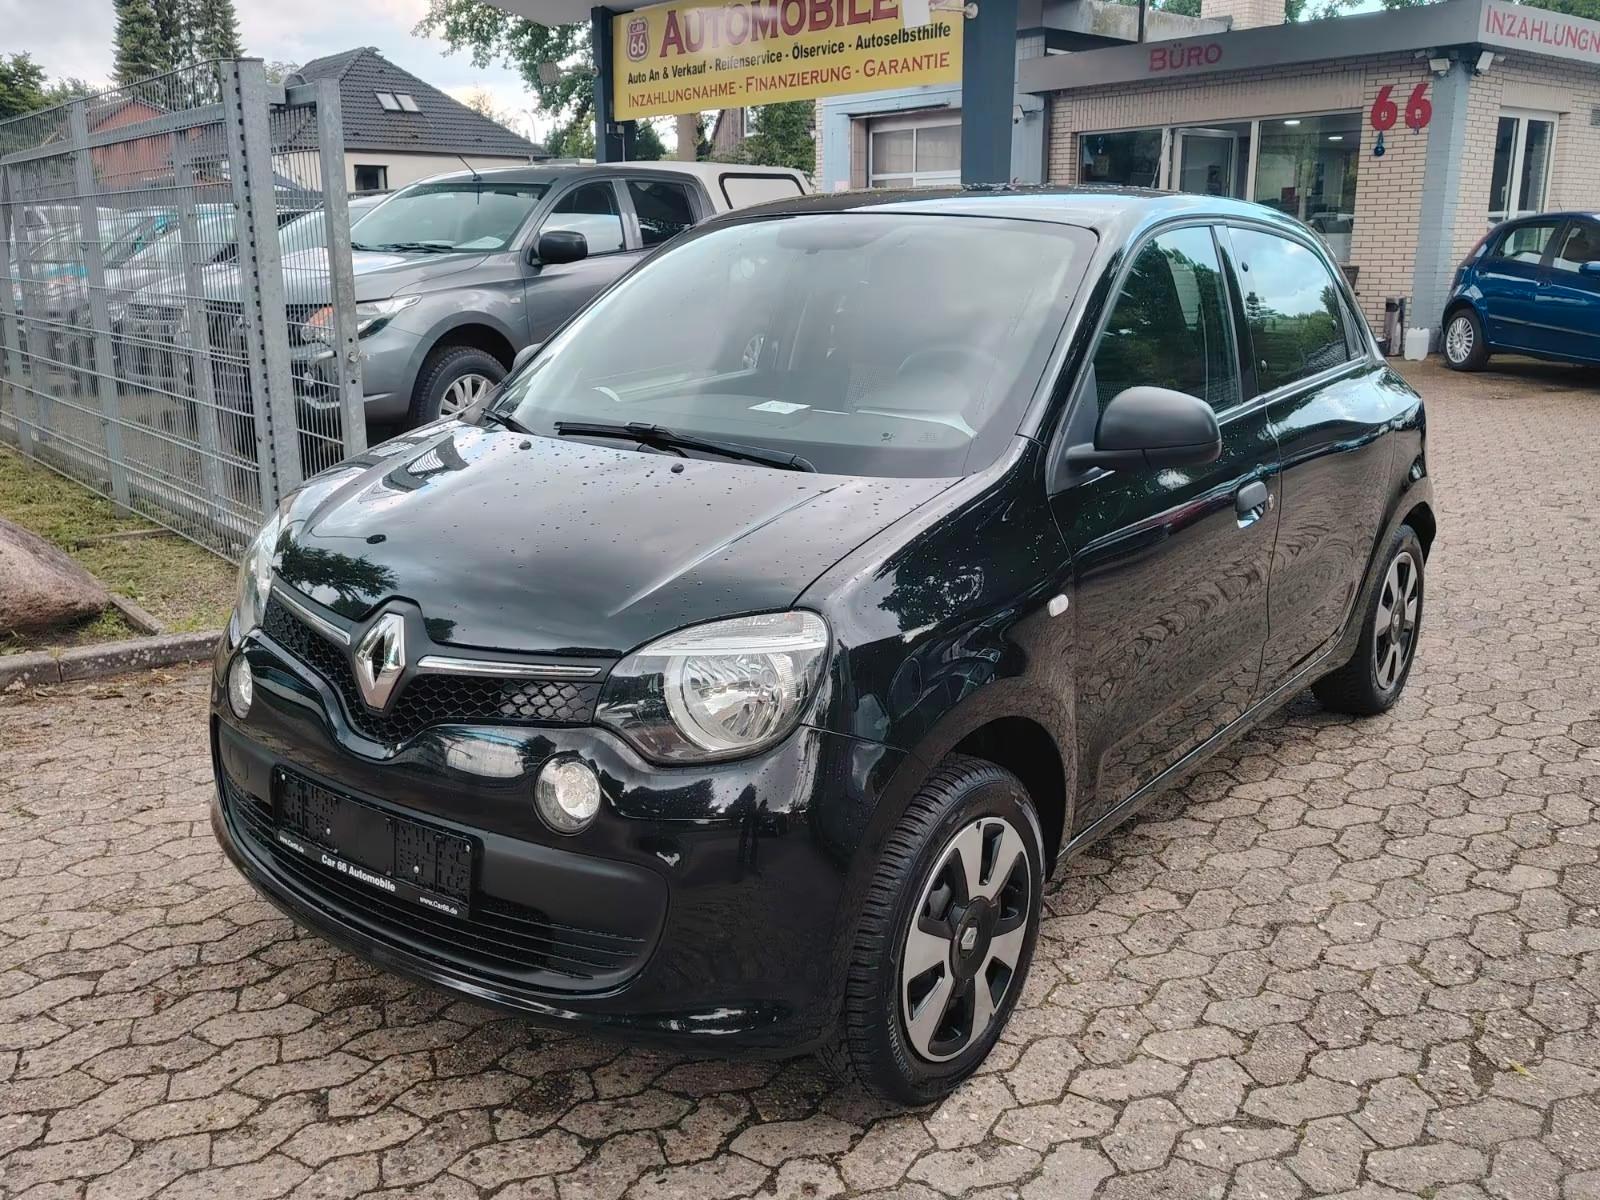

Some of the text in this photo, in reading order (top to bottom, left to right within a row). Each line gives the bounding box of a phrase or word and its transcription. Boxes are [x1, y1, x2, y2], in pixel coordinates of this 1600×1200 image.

[628, 72, 647, 84] Auto
[649, 70, 660, 81] An
[662, 68, 669, 79] &
[672, 61, 706, 78] Verkauf
[715, 49, 782, 72] Reifenservice
[792, 41, 845, 60] Ölservice
[855, 22, 951, 51] Autoselbsthilfe
[631, 34, 646, 55] 66
[1149, 43, 1223, 72] BÜRO
[628, 81, 736, 108] INZAHLUNGNAHME
[746, 65, 851, 93] FINANZIERUNG
[863, 52, 950, 77] GARANTIE
[321, 854, 396, 892] Car 66 Automobile
[419, 896, 458, 915] www.Car66.de
